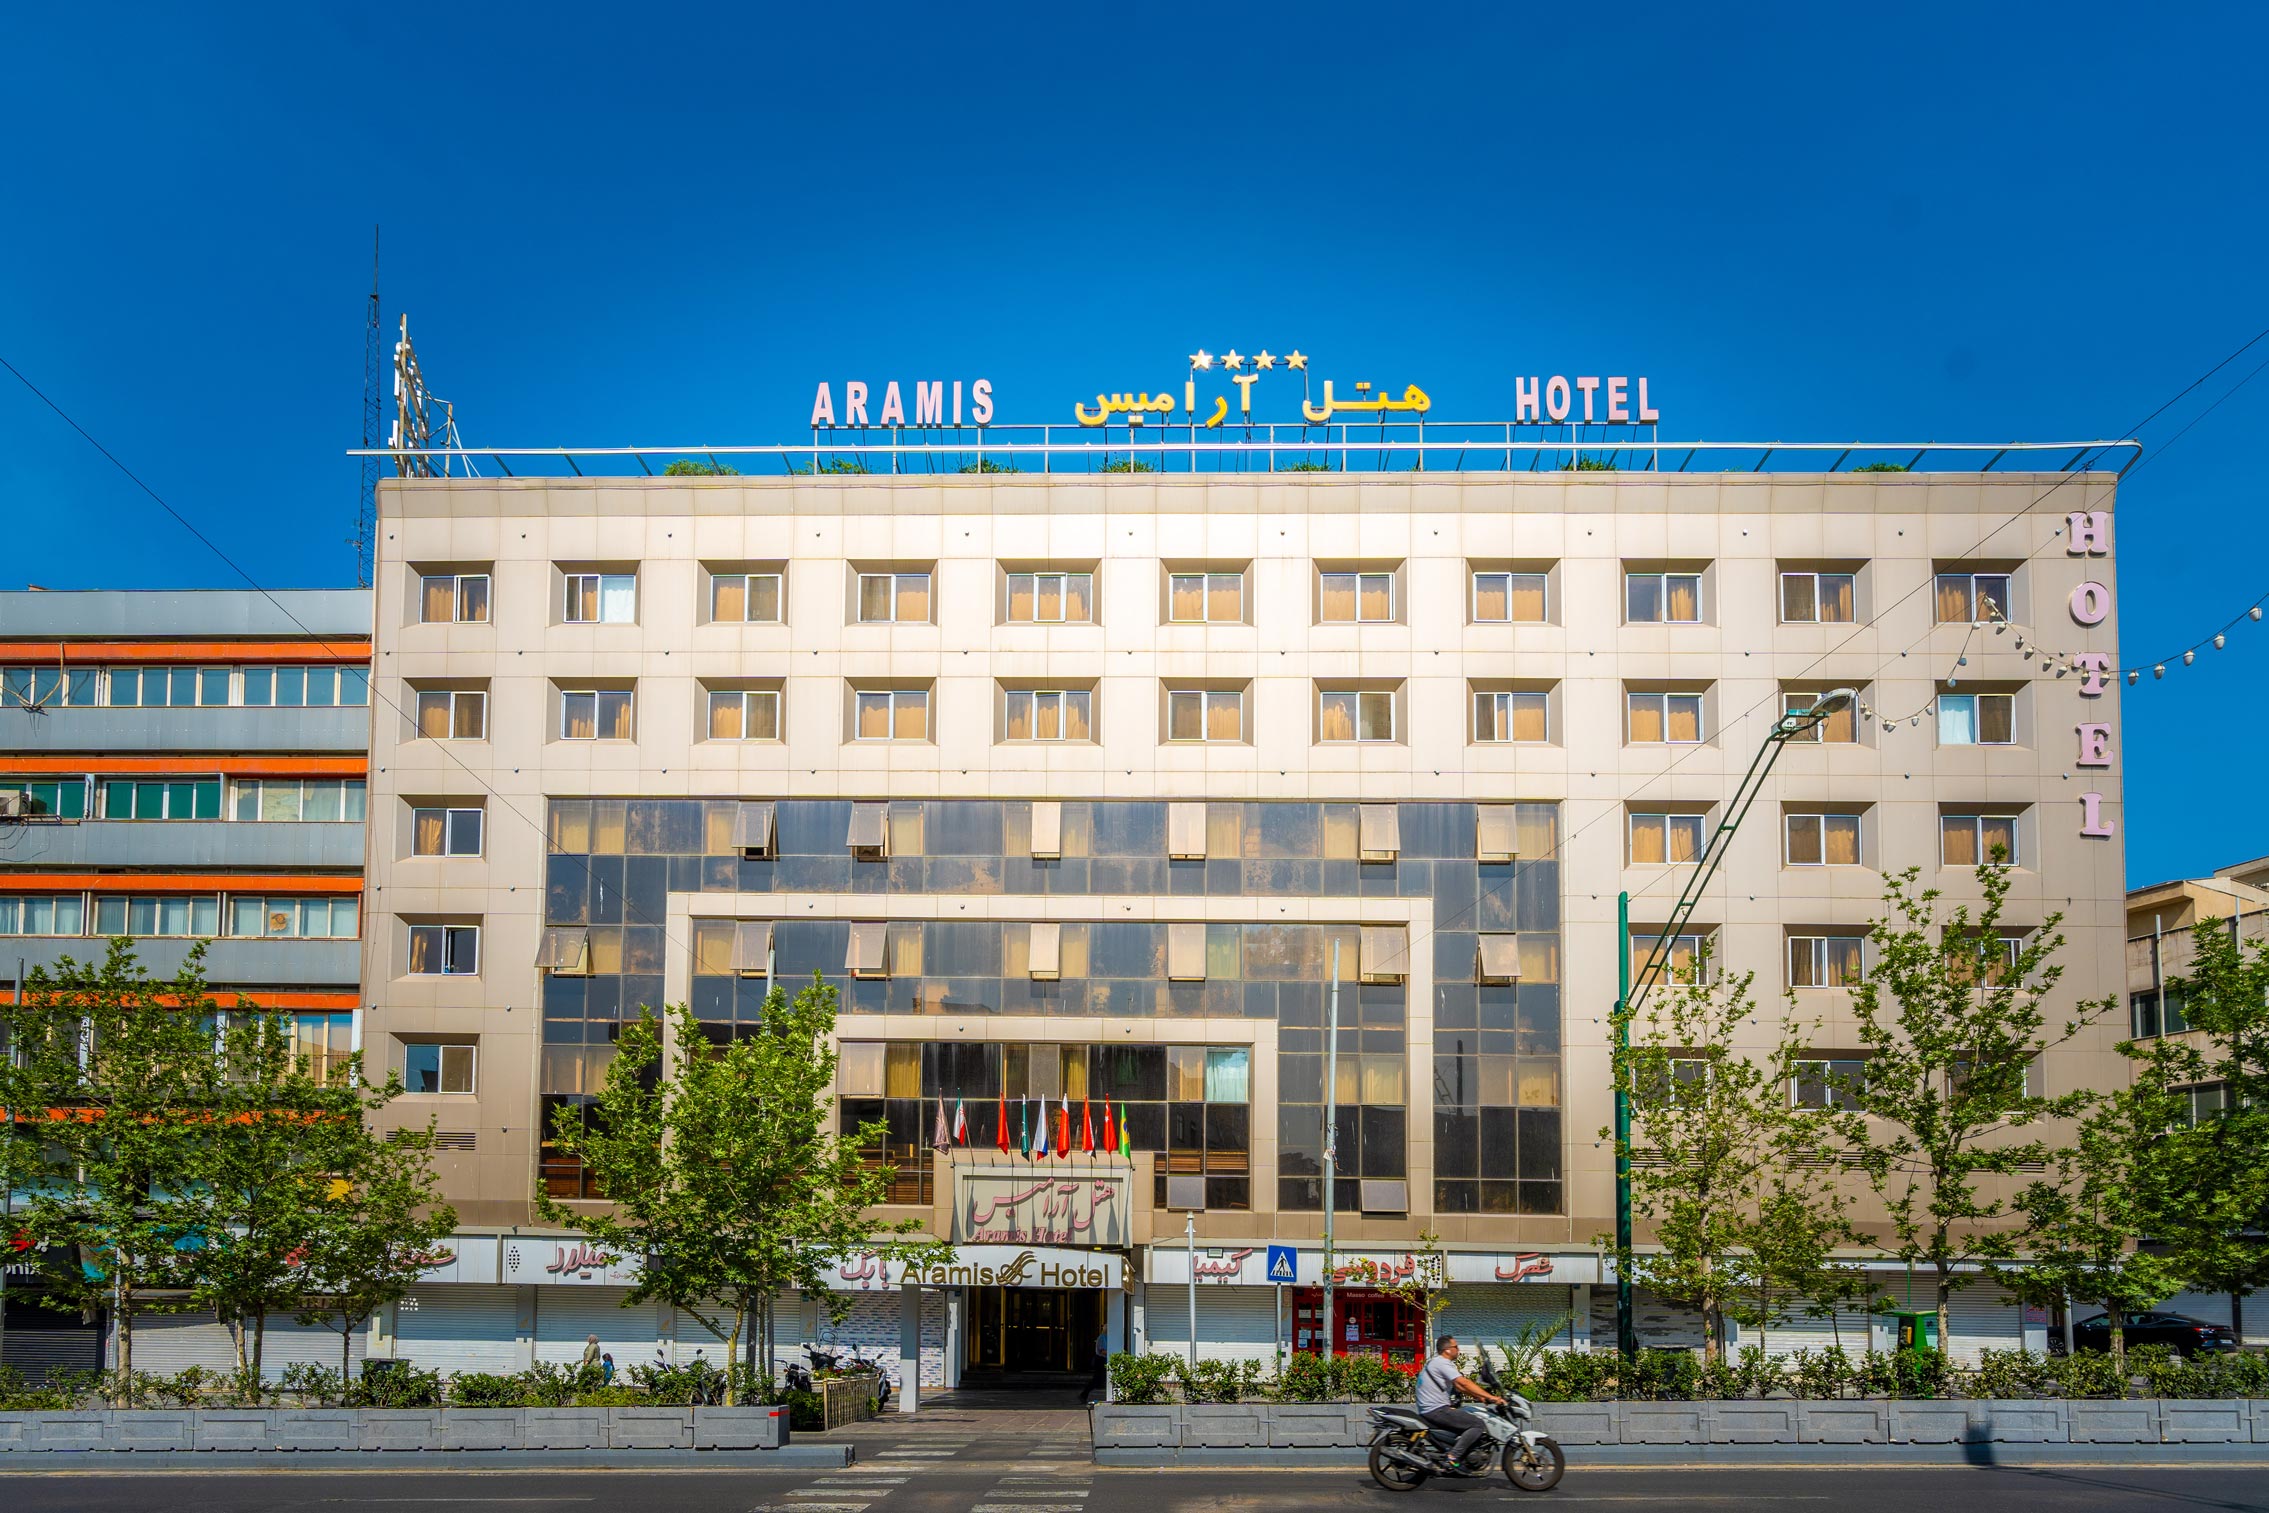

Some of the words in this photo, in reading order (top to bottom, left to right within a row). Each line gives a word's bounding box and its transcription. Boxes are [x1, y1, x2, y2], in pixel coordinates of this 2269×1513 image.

[811, 378, 994, 427] ARAMIS
[1515, 375, 1660, 424] HOTEL
[1074, 373, 1259, 428] آرامیس
[1302, 379, 1432, 424] هتل
[2066, 510, 2116, 839] HOTEL
[972, 1176, 1080, 1224] آرامیس
[1073, 1179, 1117, 1231] هتل
[971, 1226, 1028, 1242] Aramis
[1031, 1226, 1075, 1242] Hotel
[900, 1262, 994, 1285] Aramis
[1041, 1262, 1109, 1287] Hotel
[1192, 1247, 1253, 1283] کیمیا
[1325, 1252, 1415, 1285] فردوسی
